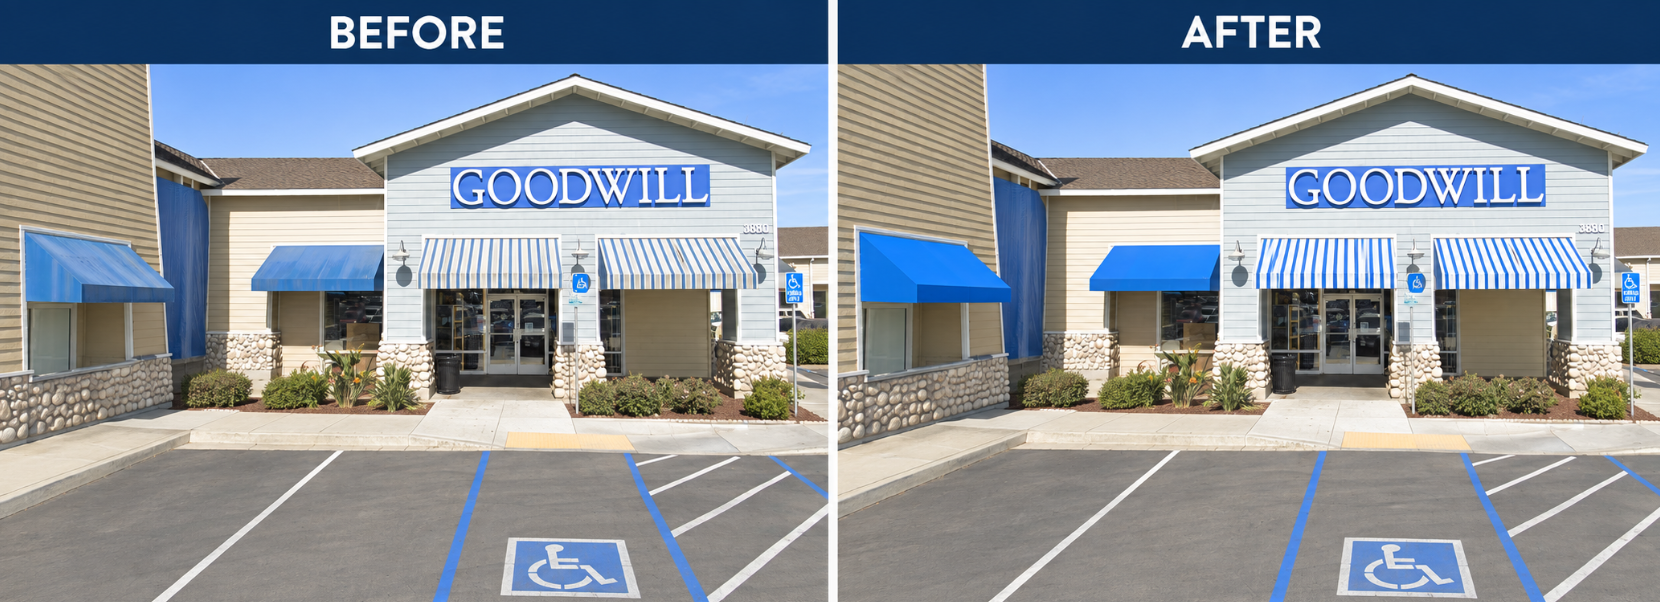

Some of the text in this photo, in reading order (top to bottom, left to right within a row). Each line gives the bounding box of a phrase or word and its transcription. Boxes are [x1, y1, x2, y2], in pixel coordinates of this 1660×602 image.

[452, 166, 709, 206] GOODWILL
[1287, 166, 1545, 206] GOODWILL
[743, 223, 769, 234] 3880
[1579, 224, 1605, 234] 3880
